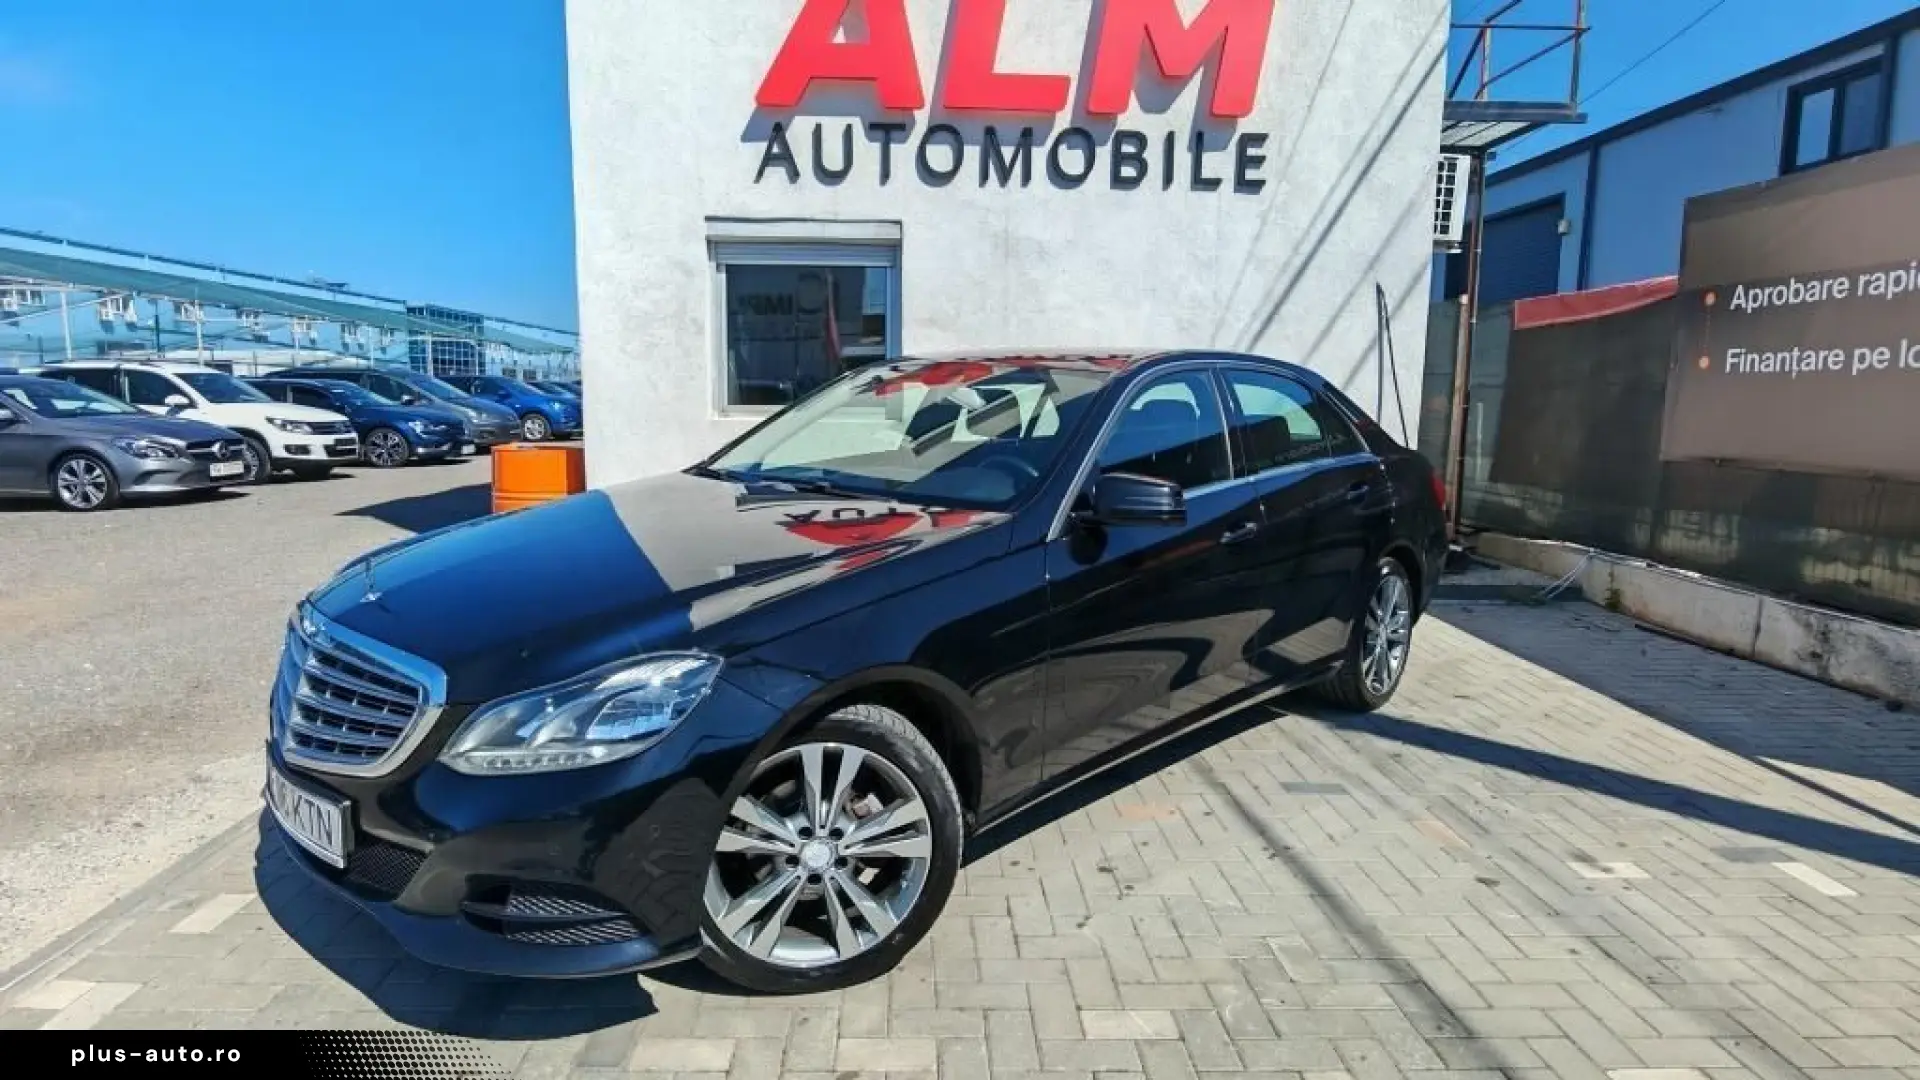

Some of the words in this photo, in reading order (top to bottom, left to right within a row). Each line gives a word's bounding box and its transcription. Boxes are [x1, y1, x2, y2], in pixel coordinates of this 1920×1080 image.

[755, 0, 1275, 118] ALM
[754, 122, 1269, 193] AUTOMOBILE
[1729, 276, 1850, 314] Aprobare
[1857, 260, 1920, 300] rapi
[1724, 346, 1846, 380] Finanțare
[1851, 345, 1891, 376] pe
